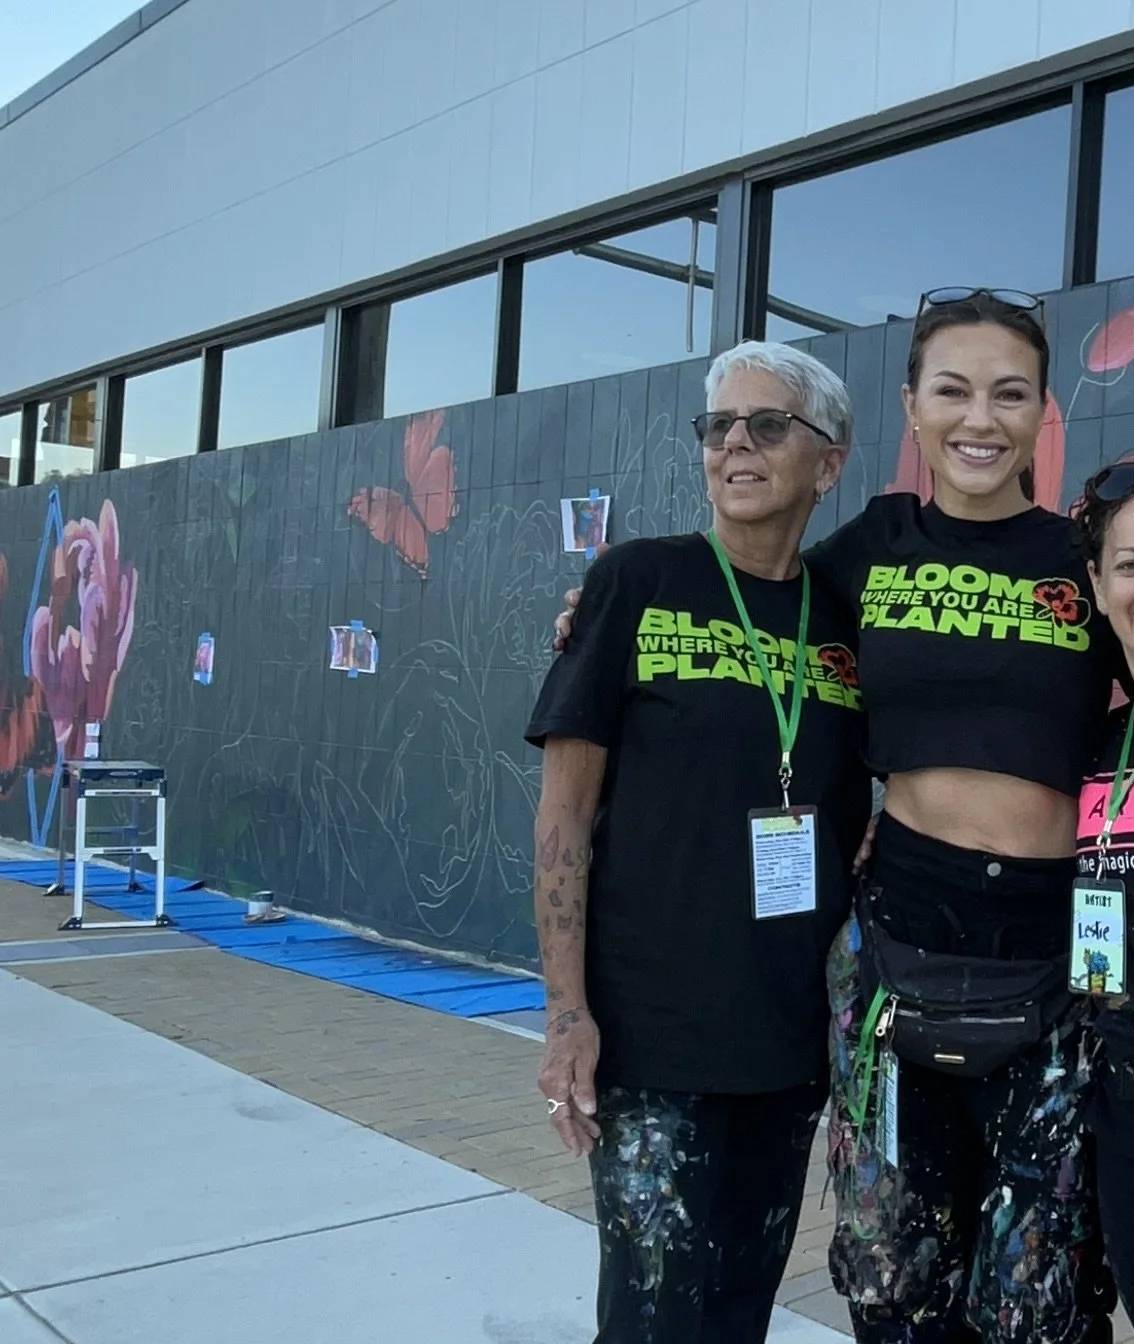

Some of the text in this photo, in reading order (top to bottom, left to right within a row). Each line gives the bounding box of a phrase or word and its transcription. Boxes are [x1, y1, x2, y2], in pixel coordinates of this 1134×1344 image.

[866, 563, 1037, 604] BLOOM
[860, 590, 1034, 619] WHERE YOU ARE
[637, 607, 824, 667] BLOOM
[860, 604, 1090, 652] PLANTED
[636, 636, 728, 654] WHERE
[732, 646, 778, 669] YOU
